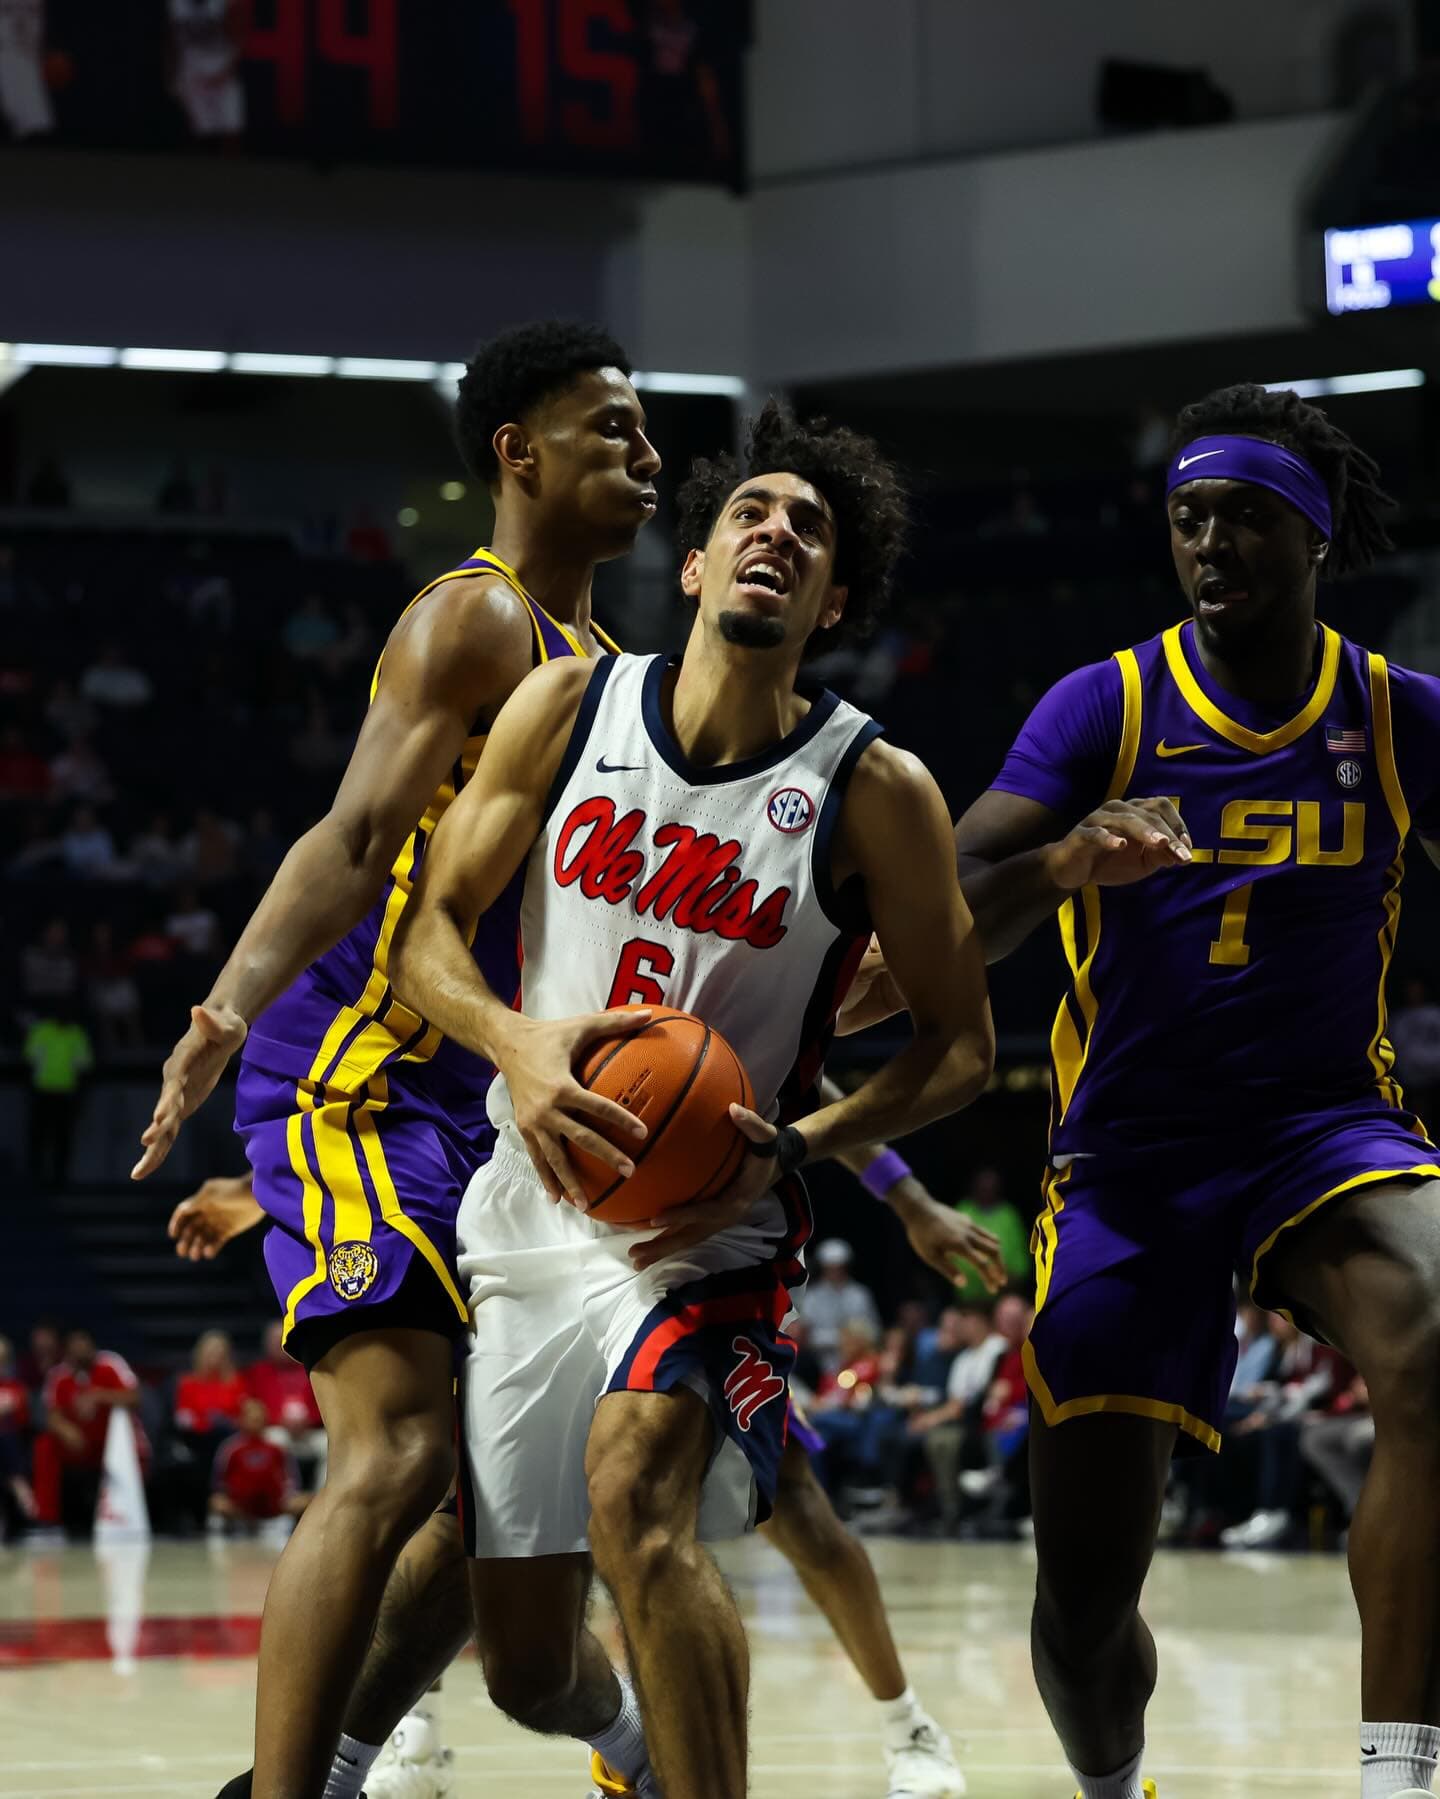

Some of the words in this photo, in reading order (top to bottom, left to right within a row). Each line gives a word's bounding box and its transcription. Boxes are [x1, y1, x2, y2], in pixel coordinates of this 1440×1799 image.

[509, 0, 640, 147] 15
[769, 790, 811, 830] SEC
[1339, 761, 1360, 787] SEC
[1167, 796, 1366, 866] SU
[553, 796, 646, 905] Ole
[635, 822, 791, 949] Miss
[1208, 880, 1254, 967] 1
[605, 937, 675, 1010] 6
